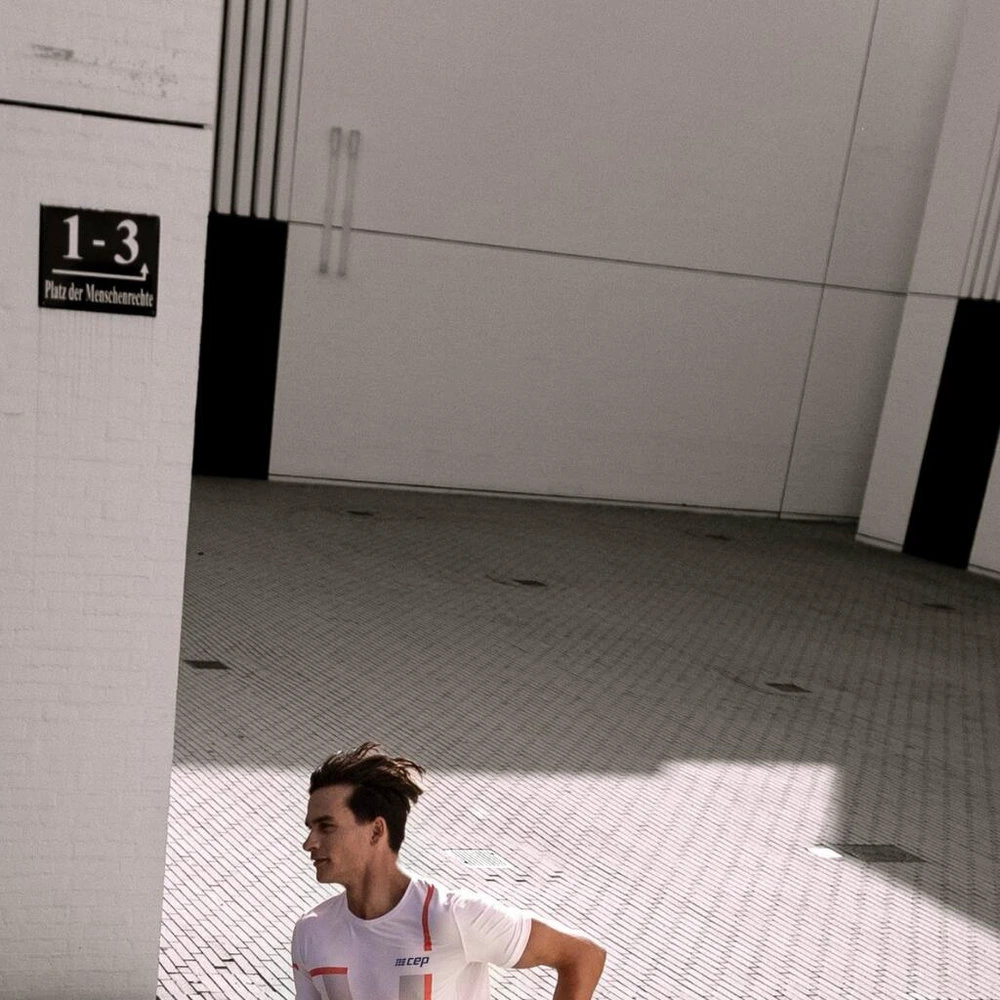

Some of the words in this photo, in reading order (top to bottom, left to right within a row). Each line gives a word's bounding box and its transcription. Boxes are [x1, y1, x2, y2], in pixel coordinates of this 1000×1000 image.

[44, 279, 67, 300] Platz
[68, 282, 83, 301] der
[85, 283, 154, 307] Menschenrechte
[406, 956, 429, 968] cep
